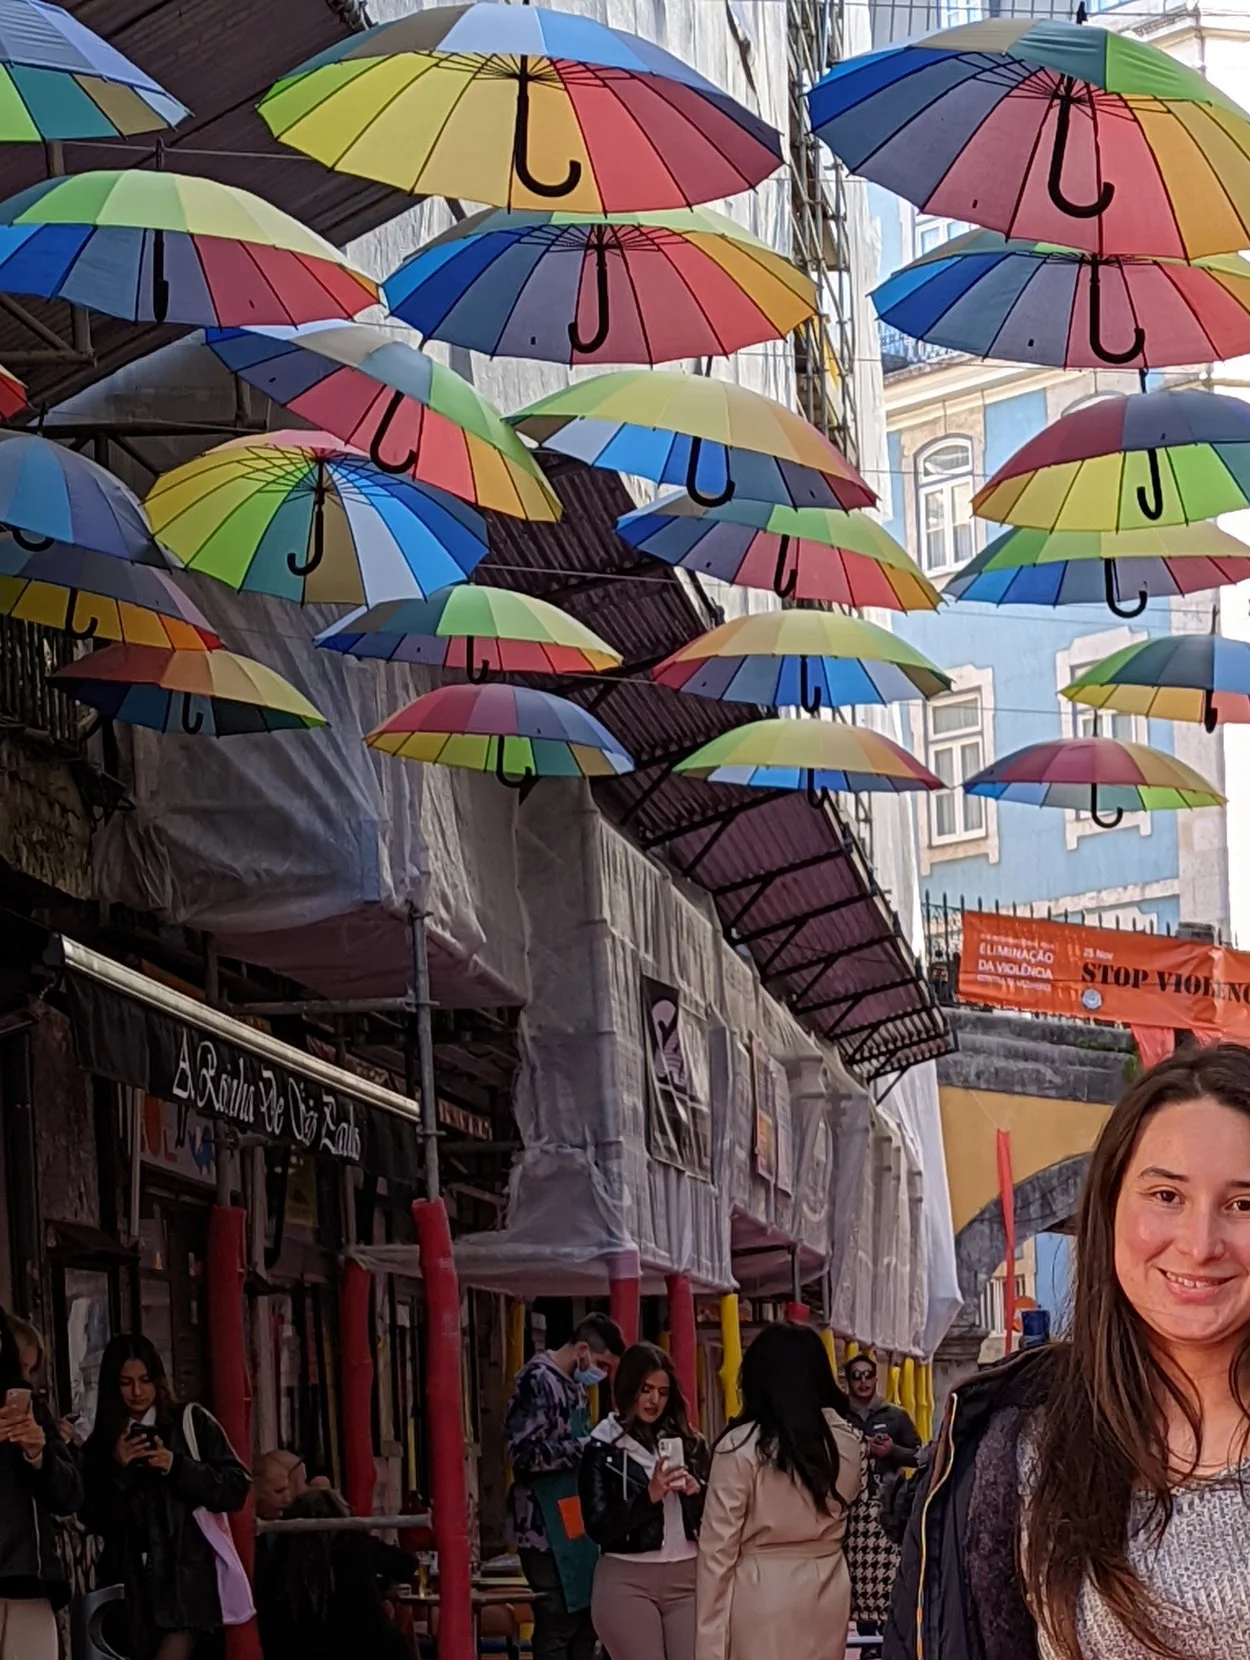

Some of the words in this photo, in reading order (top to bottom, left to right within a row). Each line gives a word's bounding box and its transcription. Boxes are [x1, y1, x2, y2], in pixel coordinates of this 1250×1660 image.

[979, 942, 1054, 963] ELIMINAÇÃO
[978, 959, 996, 972] DA
[996, 961, 1053, 980] VIOLÊNCIA
[1081, 962, 1149, 989] STOP
[173, 1027, 195, 1101] A
